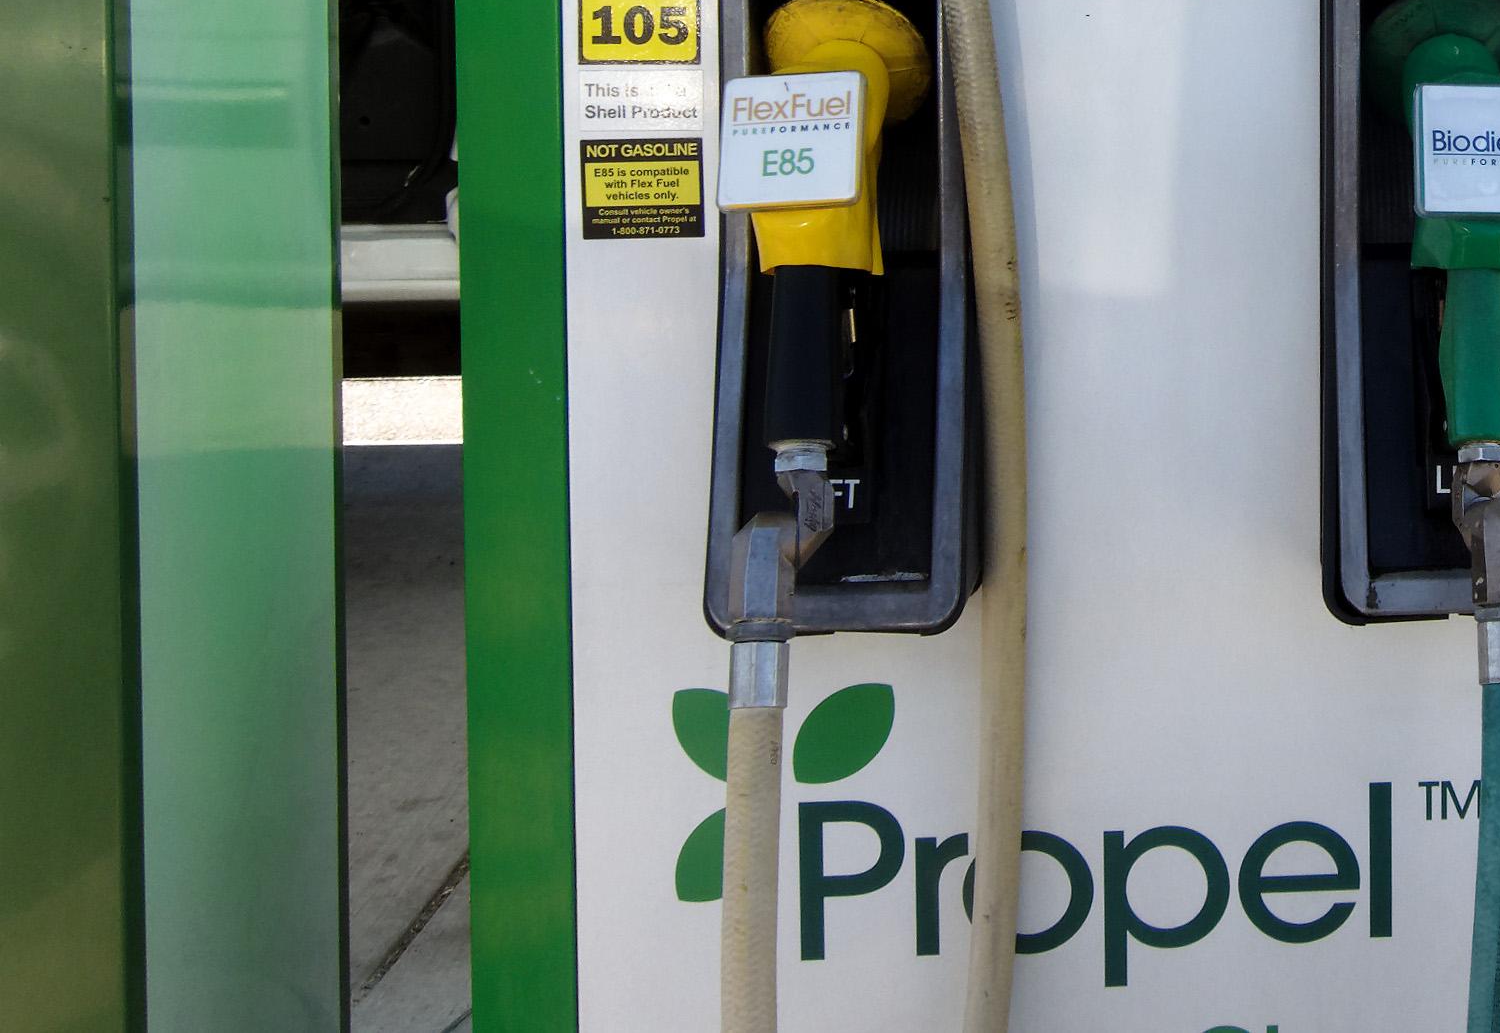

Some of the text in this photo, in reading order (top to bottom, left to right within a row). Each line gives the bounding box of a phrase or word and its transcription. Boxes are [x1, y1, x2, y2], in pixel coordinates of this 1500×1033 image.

[591, 5, 689, 46] 105
[585, 83, 620, 98] This
[585, 105, 626, 119] Shell
[732, 90, 852, 122] FlexFuel
[732, 121, 851, 137] PUREFORMANCE
[586, 142, 698, 158] NOT GASOLINE
[762, 147, 815, 177] E85
[594, 166, 690, 178] E85 is compatible
[604, 178, 680, 189] with Flex Fuel
[606, 190, 679, 201] vehicles only.
[798, 782, 1394, 988] Propel
[1418, 780, 1482, 821] TM
